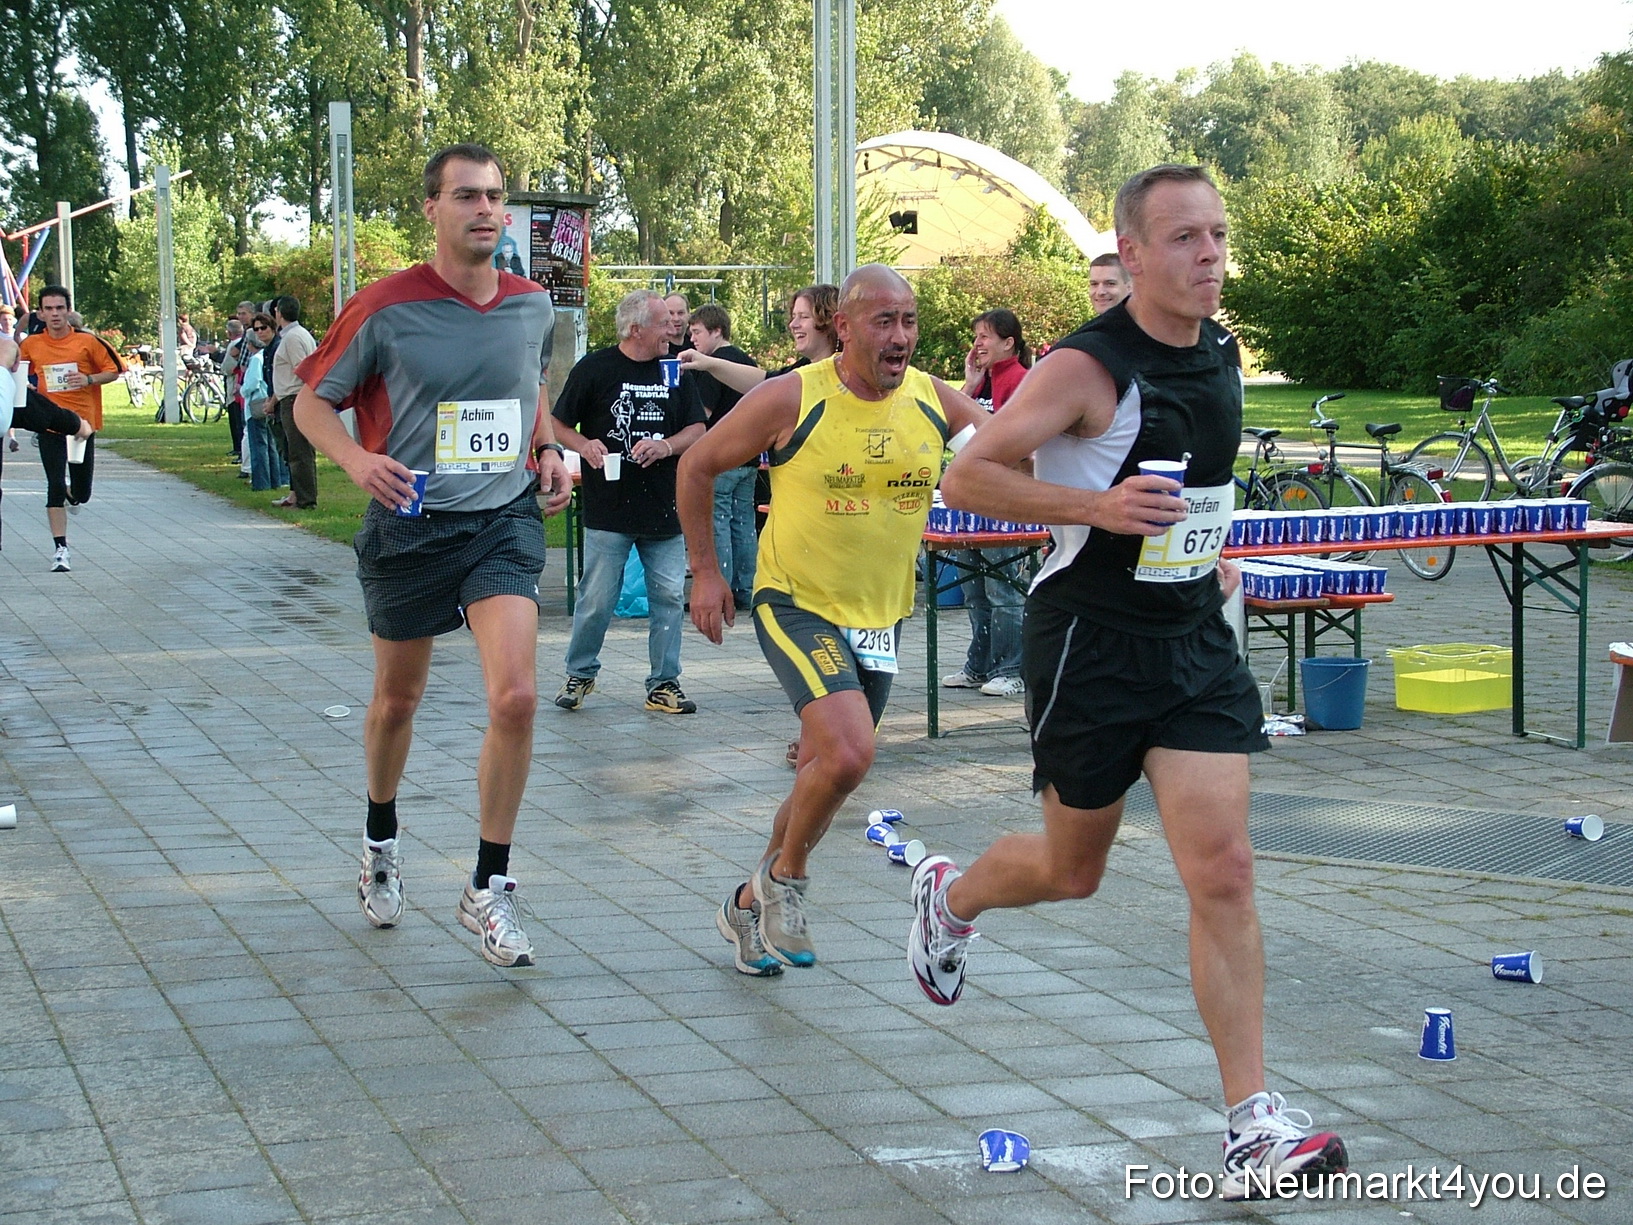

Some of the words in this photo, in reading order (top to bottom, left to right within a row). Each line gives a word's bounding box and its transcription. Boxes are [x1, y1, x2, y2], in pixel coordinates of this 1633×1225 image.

[461, 408, 494, 421] Achim
[470, 432, 509, 453] 619
[826, 500, 839, 511] M
[845, 500, 857, 511] &
[861, 499, 870, 511] S
[1184, 526, 1222, 554] 673
[857, 628, 891, 652] 2319
